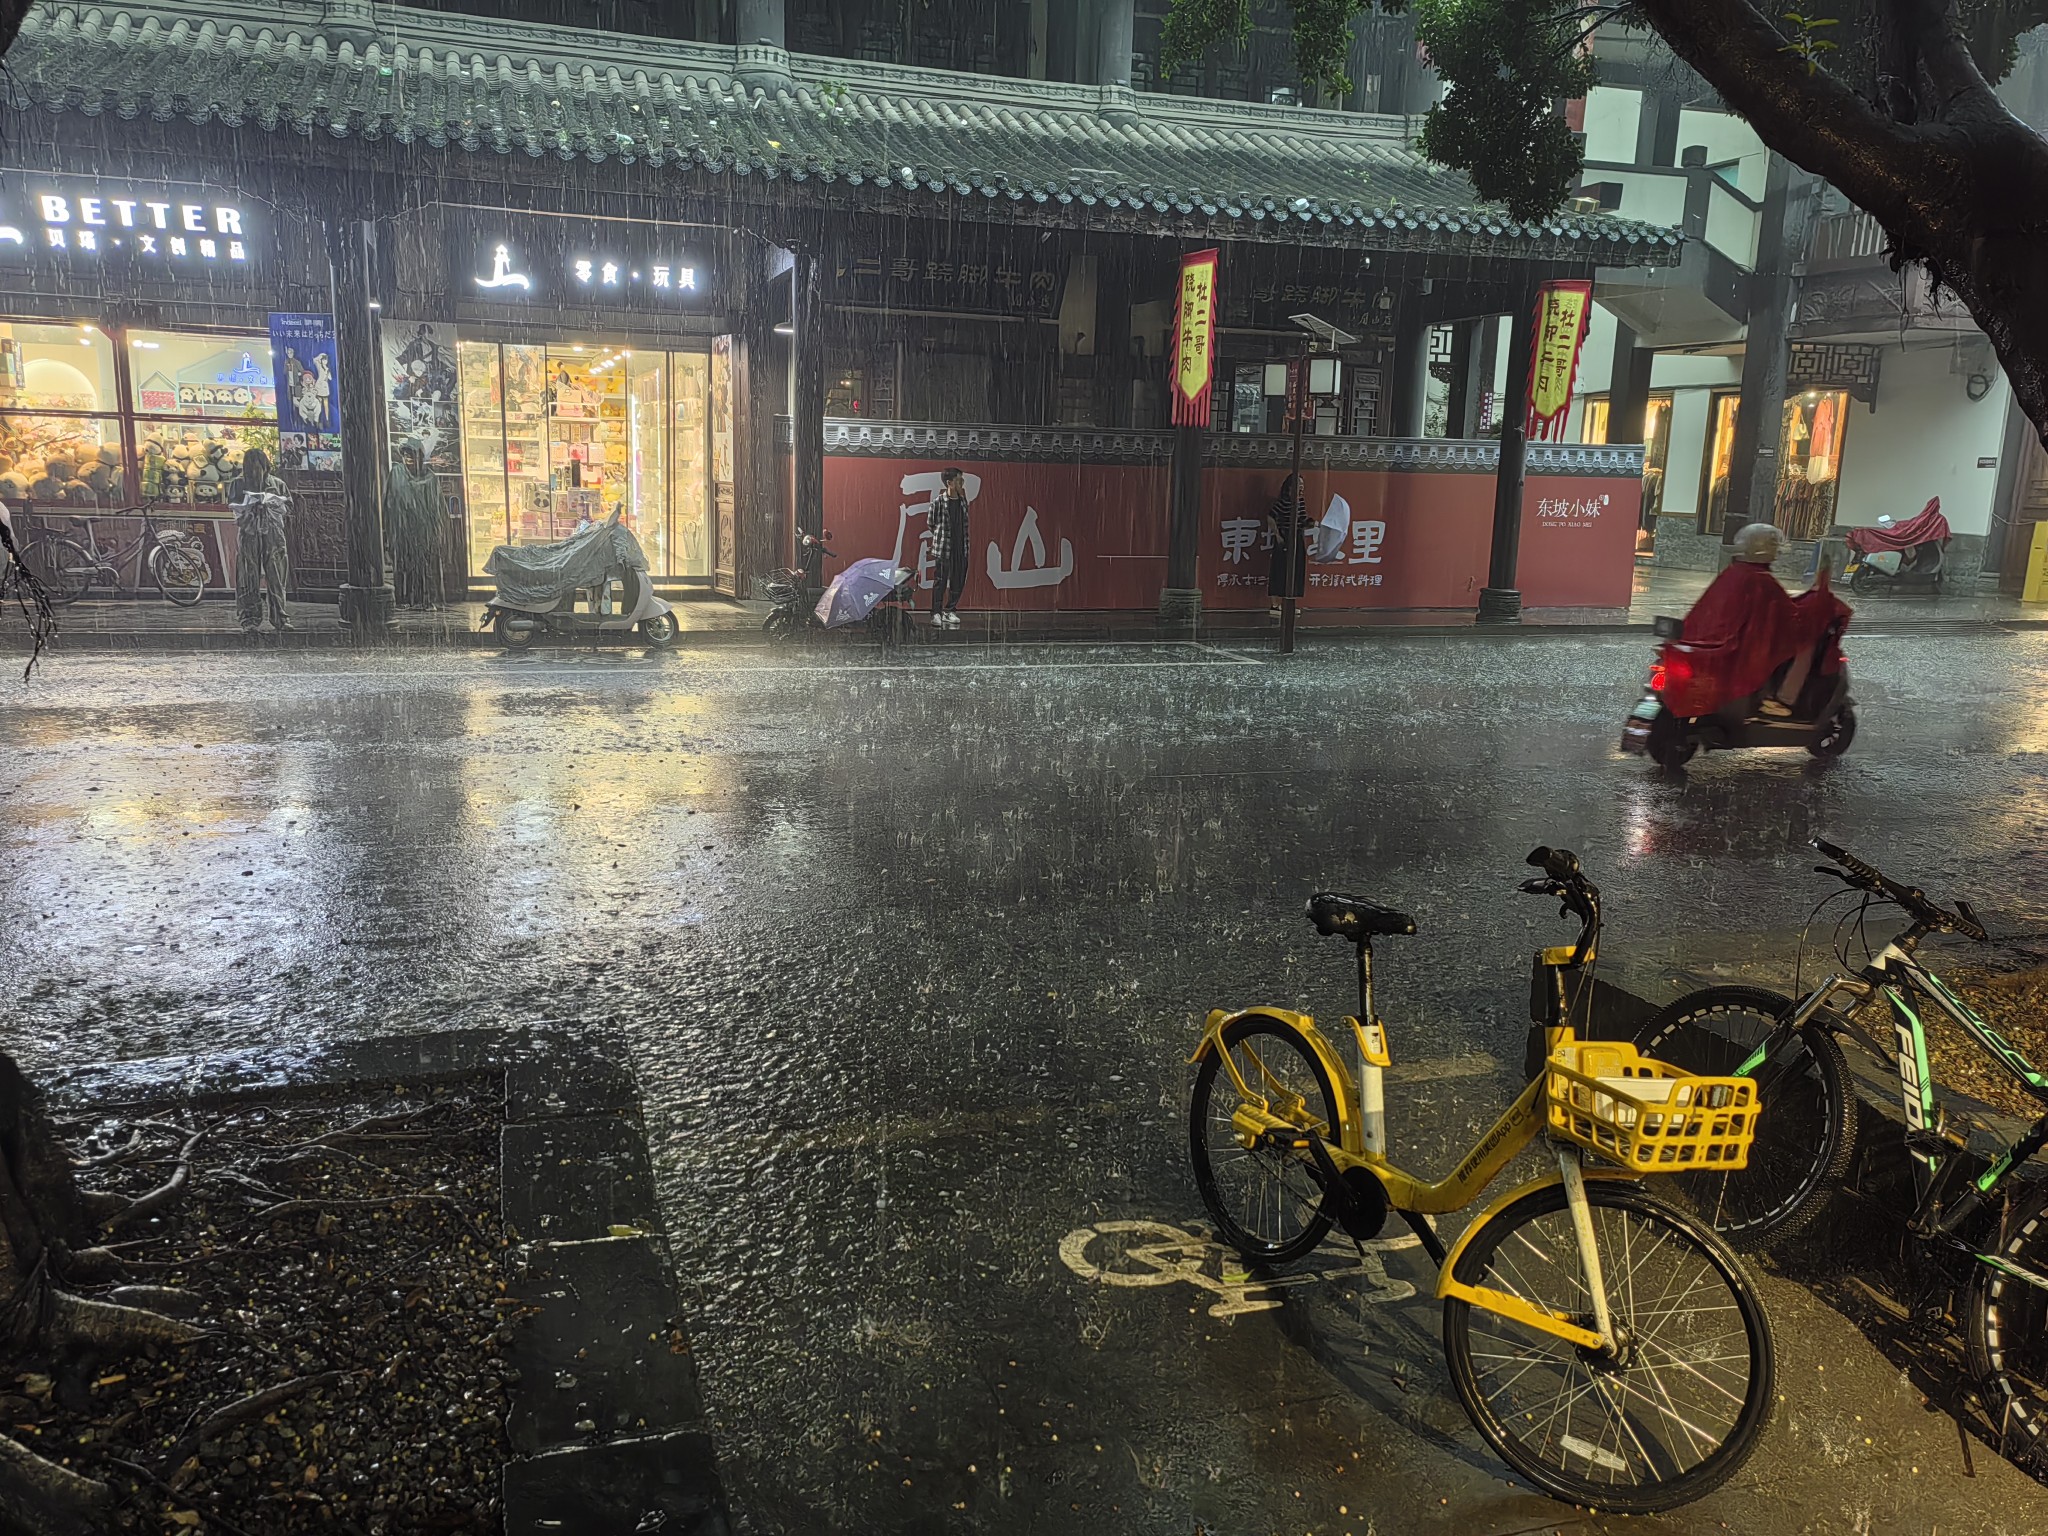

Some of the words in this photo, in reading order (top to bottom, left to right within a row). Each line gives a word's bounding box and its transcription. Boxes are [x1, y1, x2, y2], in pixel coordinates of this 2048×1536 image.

[41, 196, 243, 234] BETTER
[576, 260, 695, 290] 零食·玩具
[1194, 282, 1207, 355] 杜二哥
[1556, 309, 1575, 377] 杜二哥
[1536, 498, 1602, 518] 东坡小妹
